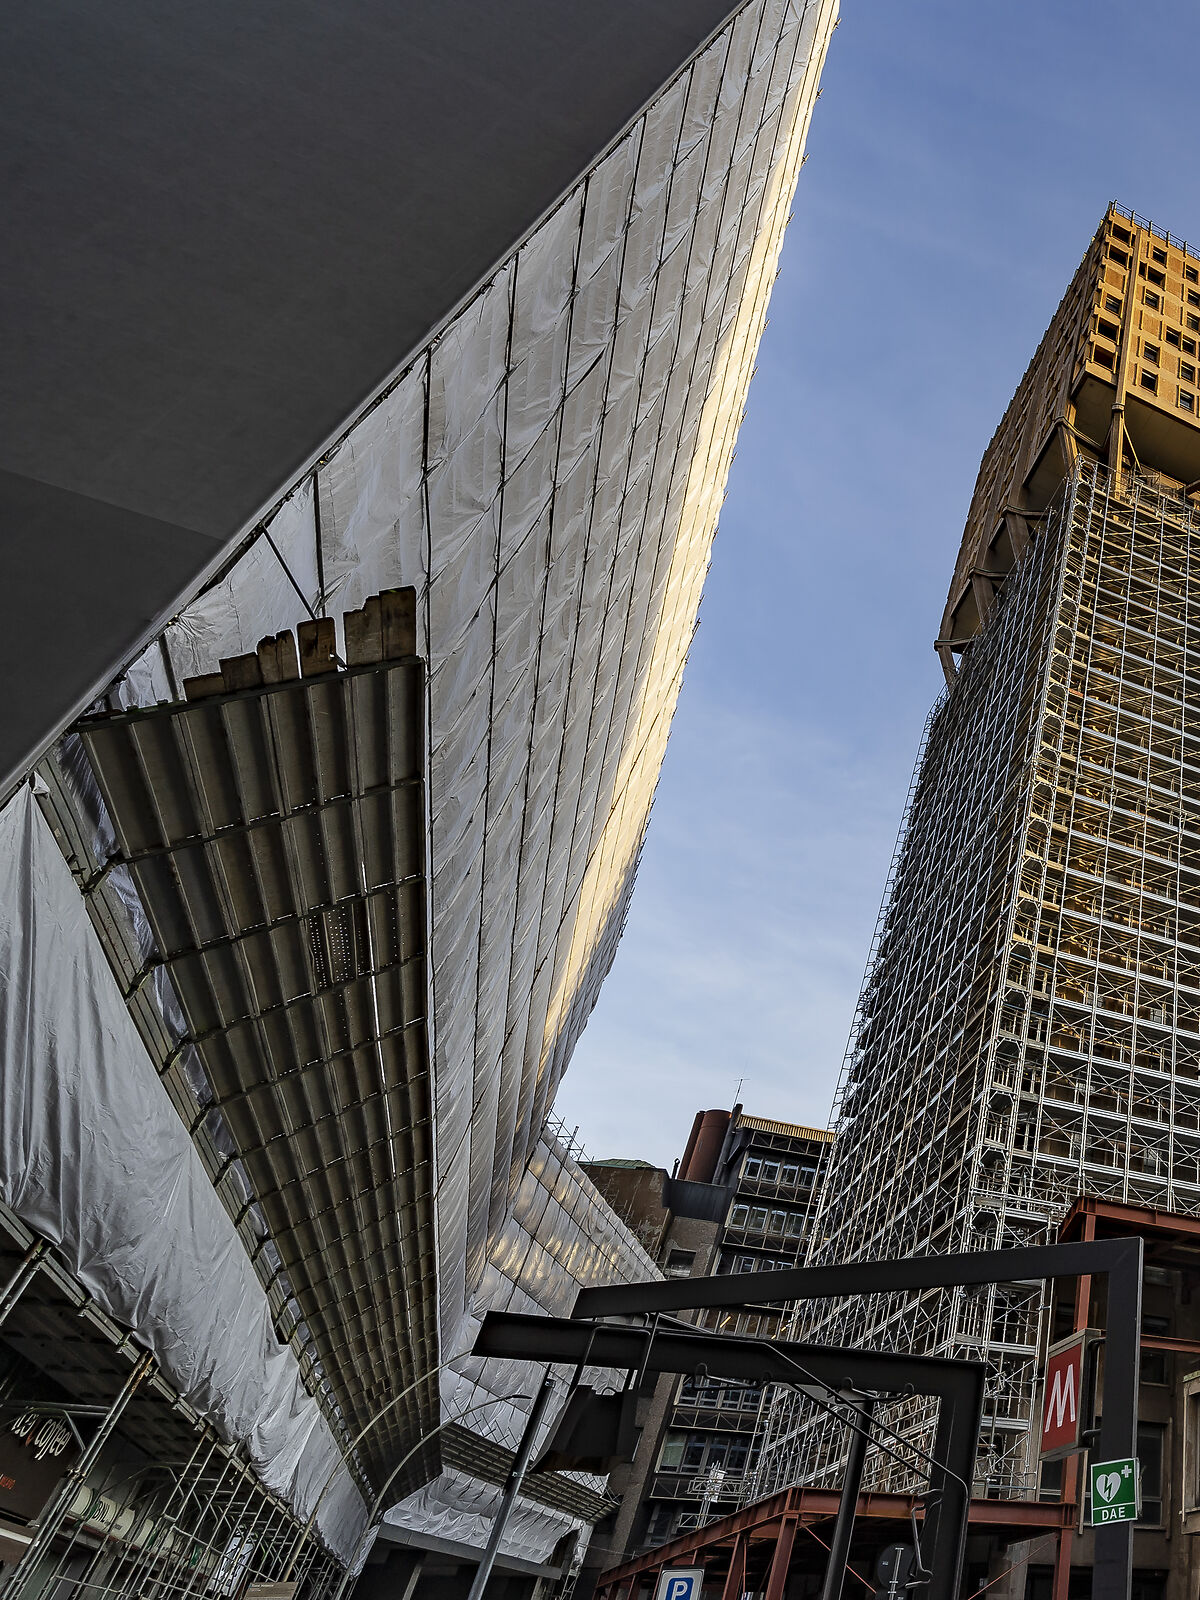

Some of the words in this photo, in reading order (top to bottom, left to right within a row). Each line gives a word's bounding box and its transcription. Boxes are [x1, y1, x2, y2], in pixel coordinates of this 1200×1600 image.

[1044, 1363, 1076, 1433] M
[34, 1418, 73, 1461] coffee
[1101, 1506, 1126, 1521] DAE
[671, 1580, 688, 1600] P
